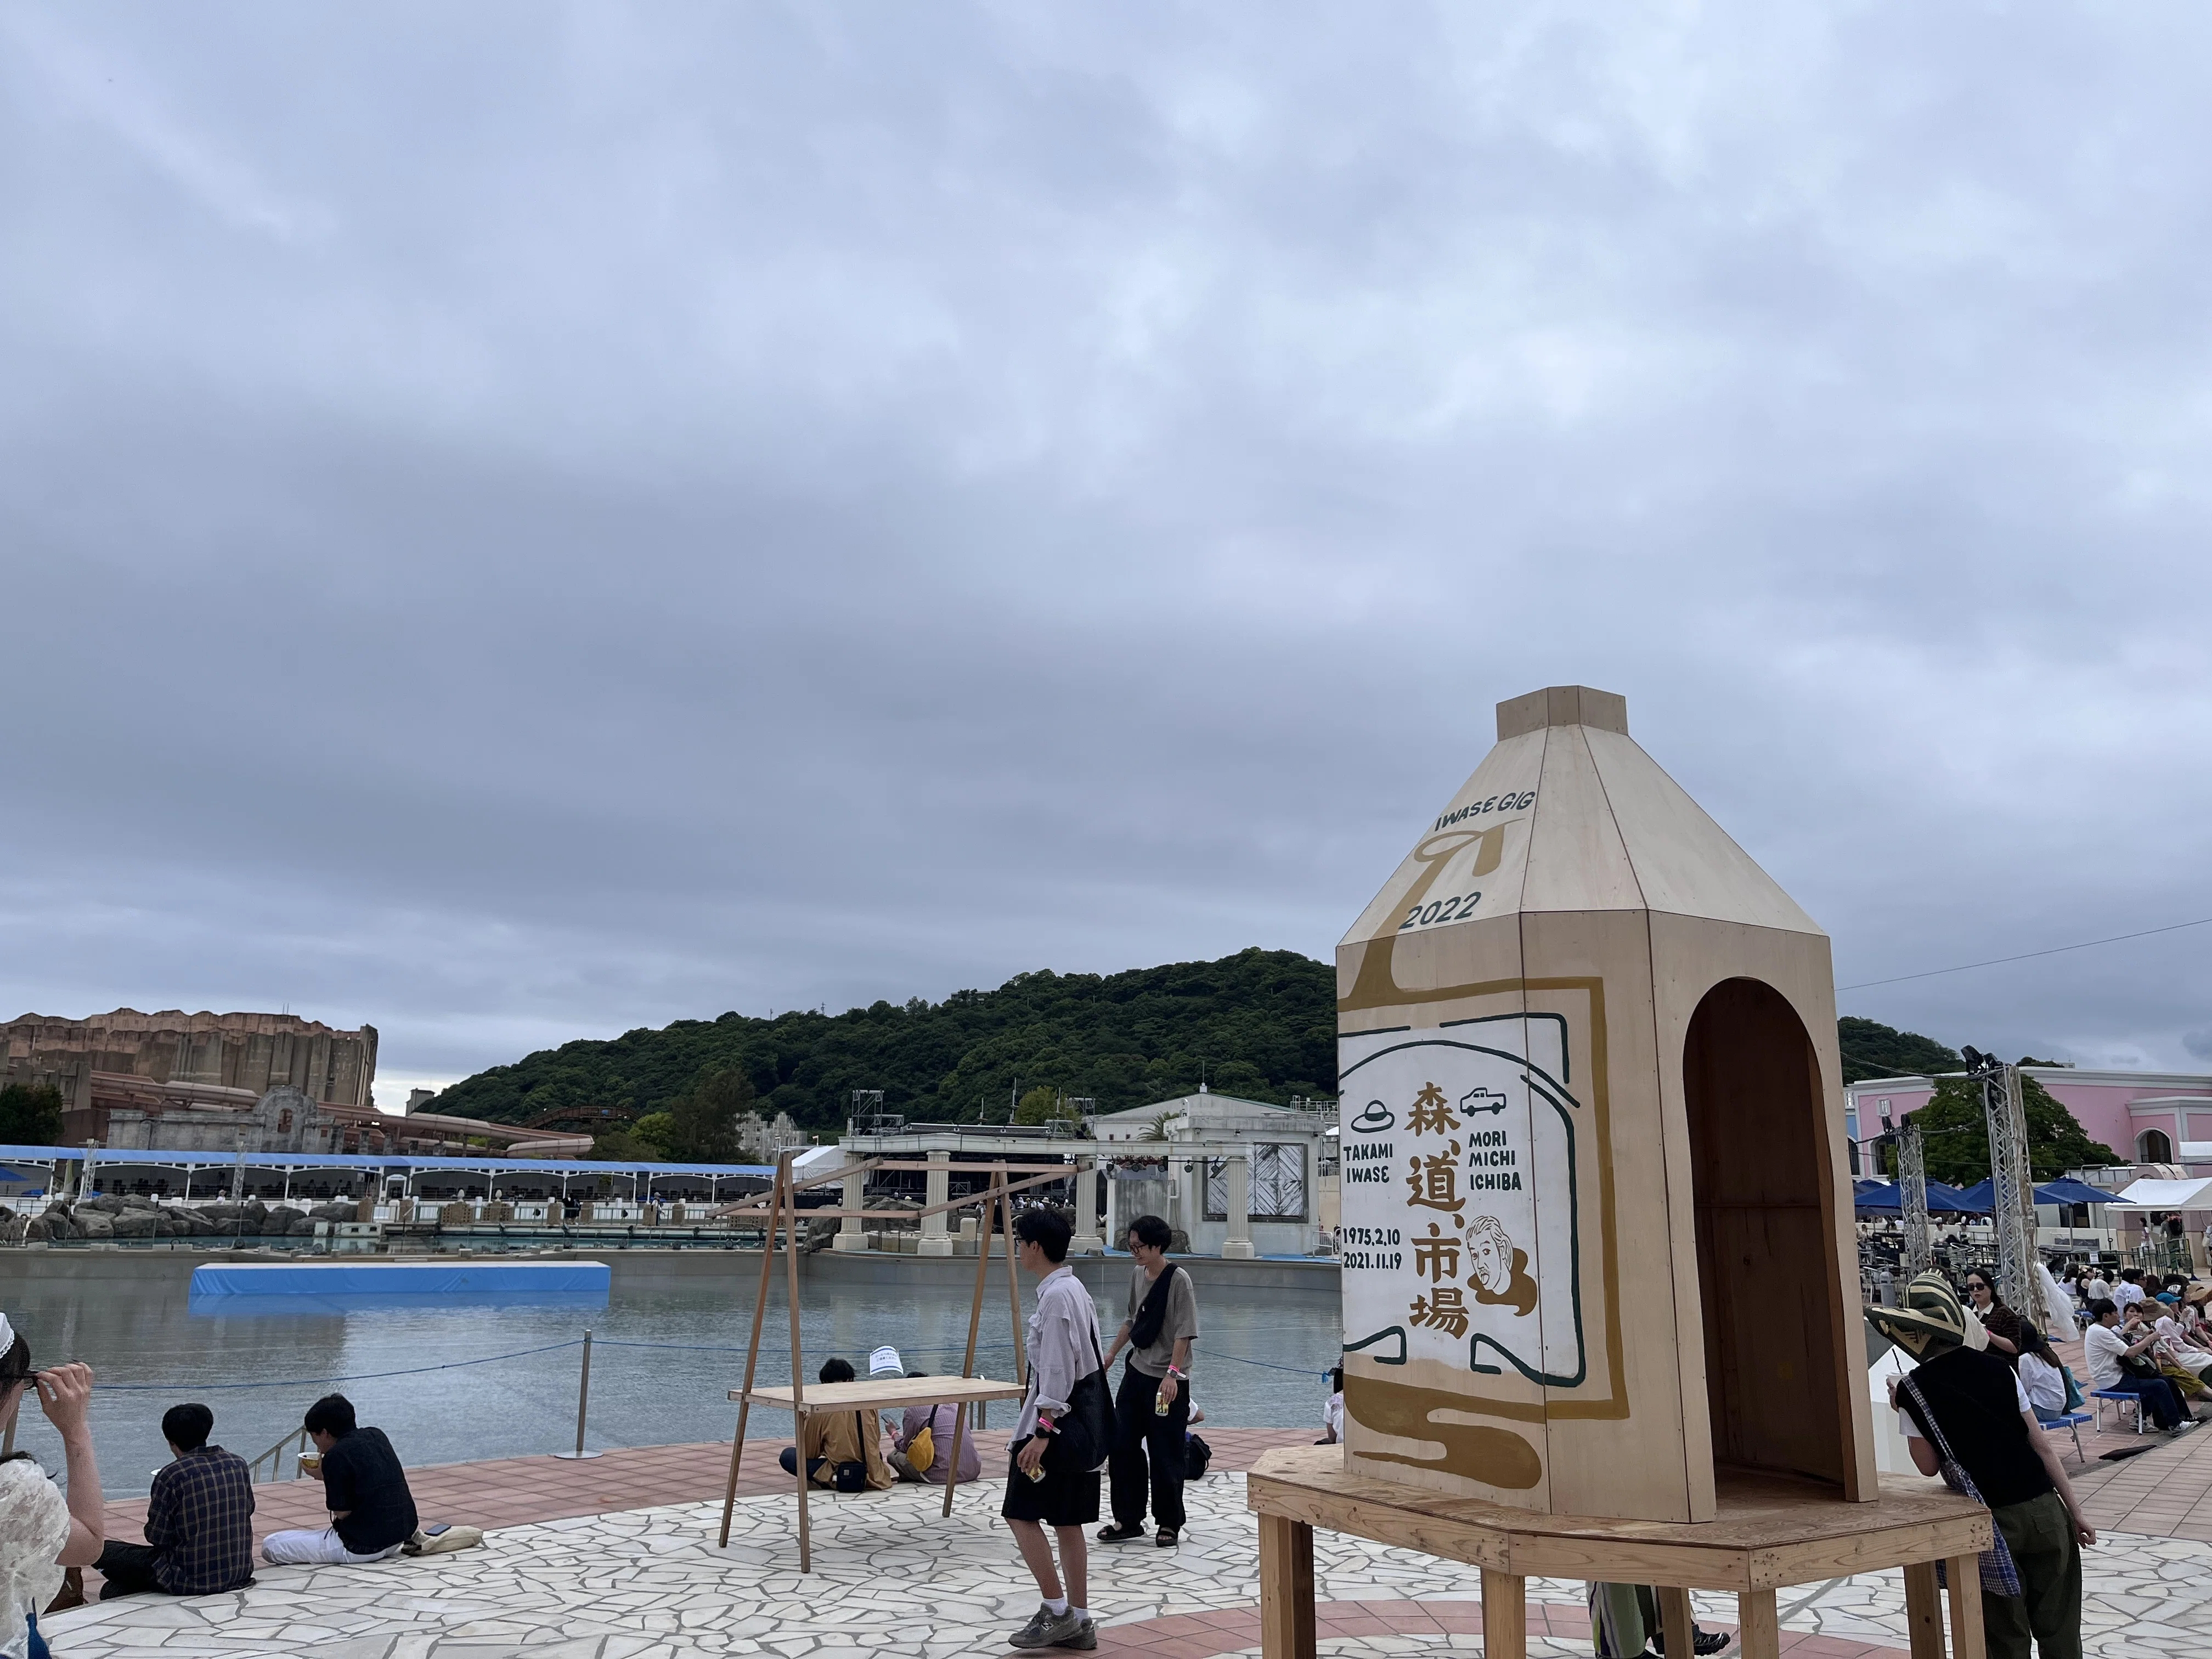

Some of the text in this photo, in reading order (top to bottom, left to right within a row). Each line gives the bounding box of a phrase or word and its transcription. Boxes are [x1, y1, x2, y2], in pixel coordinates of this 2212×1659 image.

[1434, 795, 1498, 832] IWASE
[1398, 891, 1482, 930] 2022
[1469, 1130, 1506, 1148] MORI
[1343, 1143, 1393, 1161] TAKAMI
[1469, 1150, 1515, 1167] MICHI
[1347, 1165, 1390, 1183] IWASE
[1470, 1171, 1522, 1191] ICHIBA
[1343, 1227, 1400, 1246] 1975.2.10
[1344, 1251, 1402, 1270] 2021.11.19
